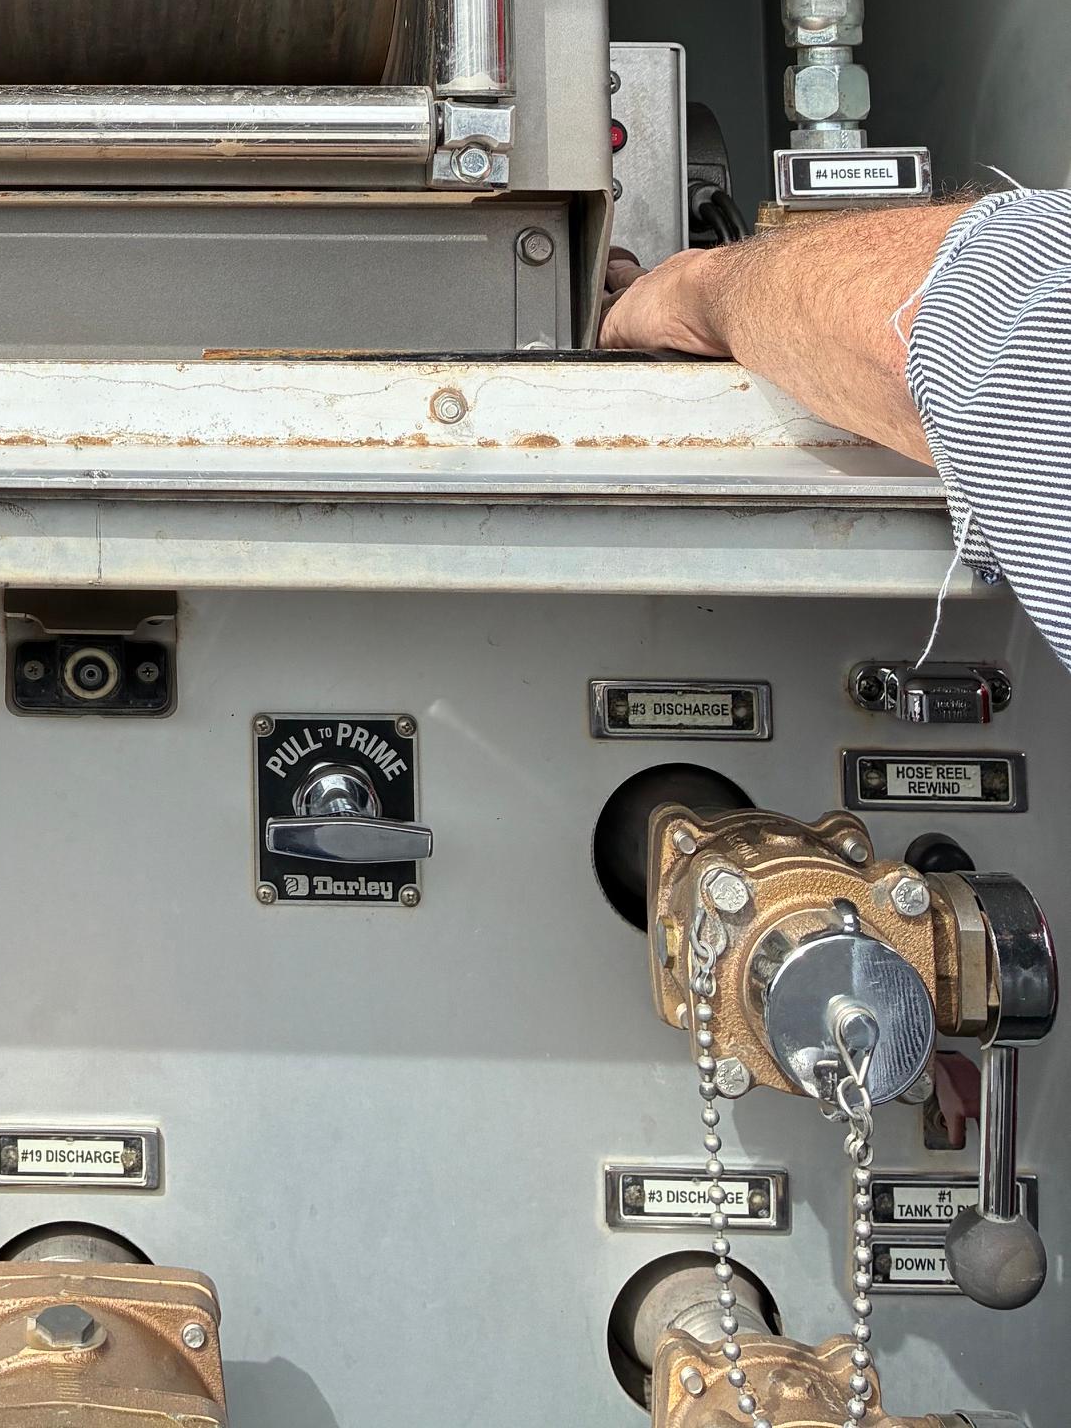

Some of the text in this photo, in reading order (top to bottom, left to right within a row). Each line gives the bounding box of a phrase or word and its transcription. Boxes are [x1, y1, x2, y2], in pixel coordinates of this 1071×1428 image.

[816, 168, 893, 179] #4 HOSE REEL
[632, 702, 730, 716] #3 DISCHARGE
[265, 722, 408, 782] PULL TO PRIME
[896, 766, 971, 780] HOSE REEL
[908, 781, 961, 794] REWIND
[313, 876, 393, 900] Darley
[21, 1149, 120, 1164] #19 DISCHARGE
[648, 1190, 744, 1204] #3 DISCHGE
[937, 1190, 952, 1203] #1
[897, 1204, 932, 1217] TANK
[935, 1205, 954, 1217] TO
[895, 1258, 936, 1271] DOWN
